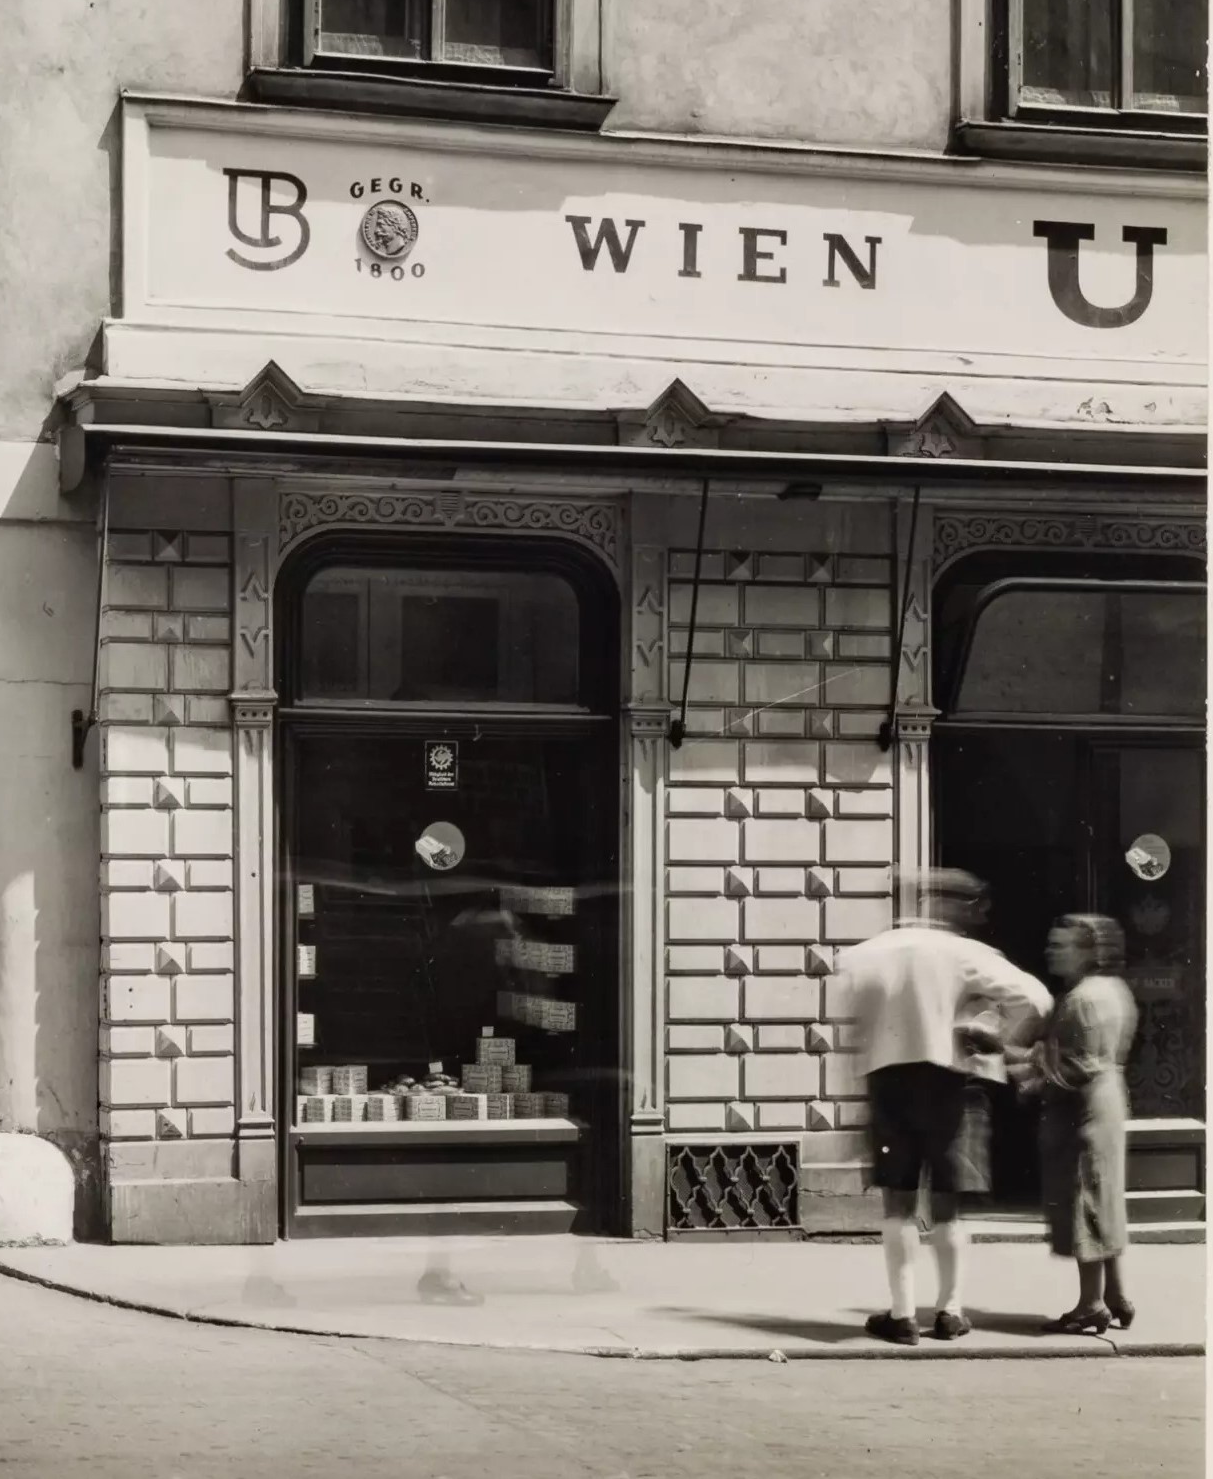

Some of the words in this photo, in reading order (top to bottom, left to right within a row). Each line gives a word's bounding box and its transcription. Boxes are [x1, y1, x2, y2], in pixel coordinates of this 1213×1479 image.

[349, 177, 430, 203] GEGR.
[354, 257, 426, 282] 1800
[564, 214, 883, 290] WIEN
[1032, 219, 1168, 329] U
